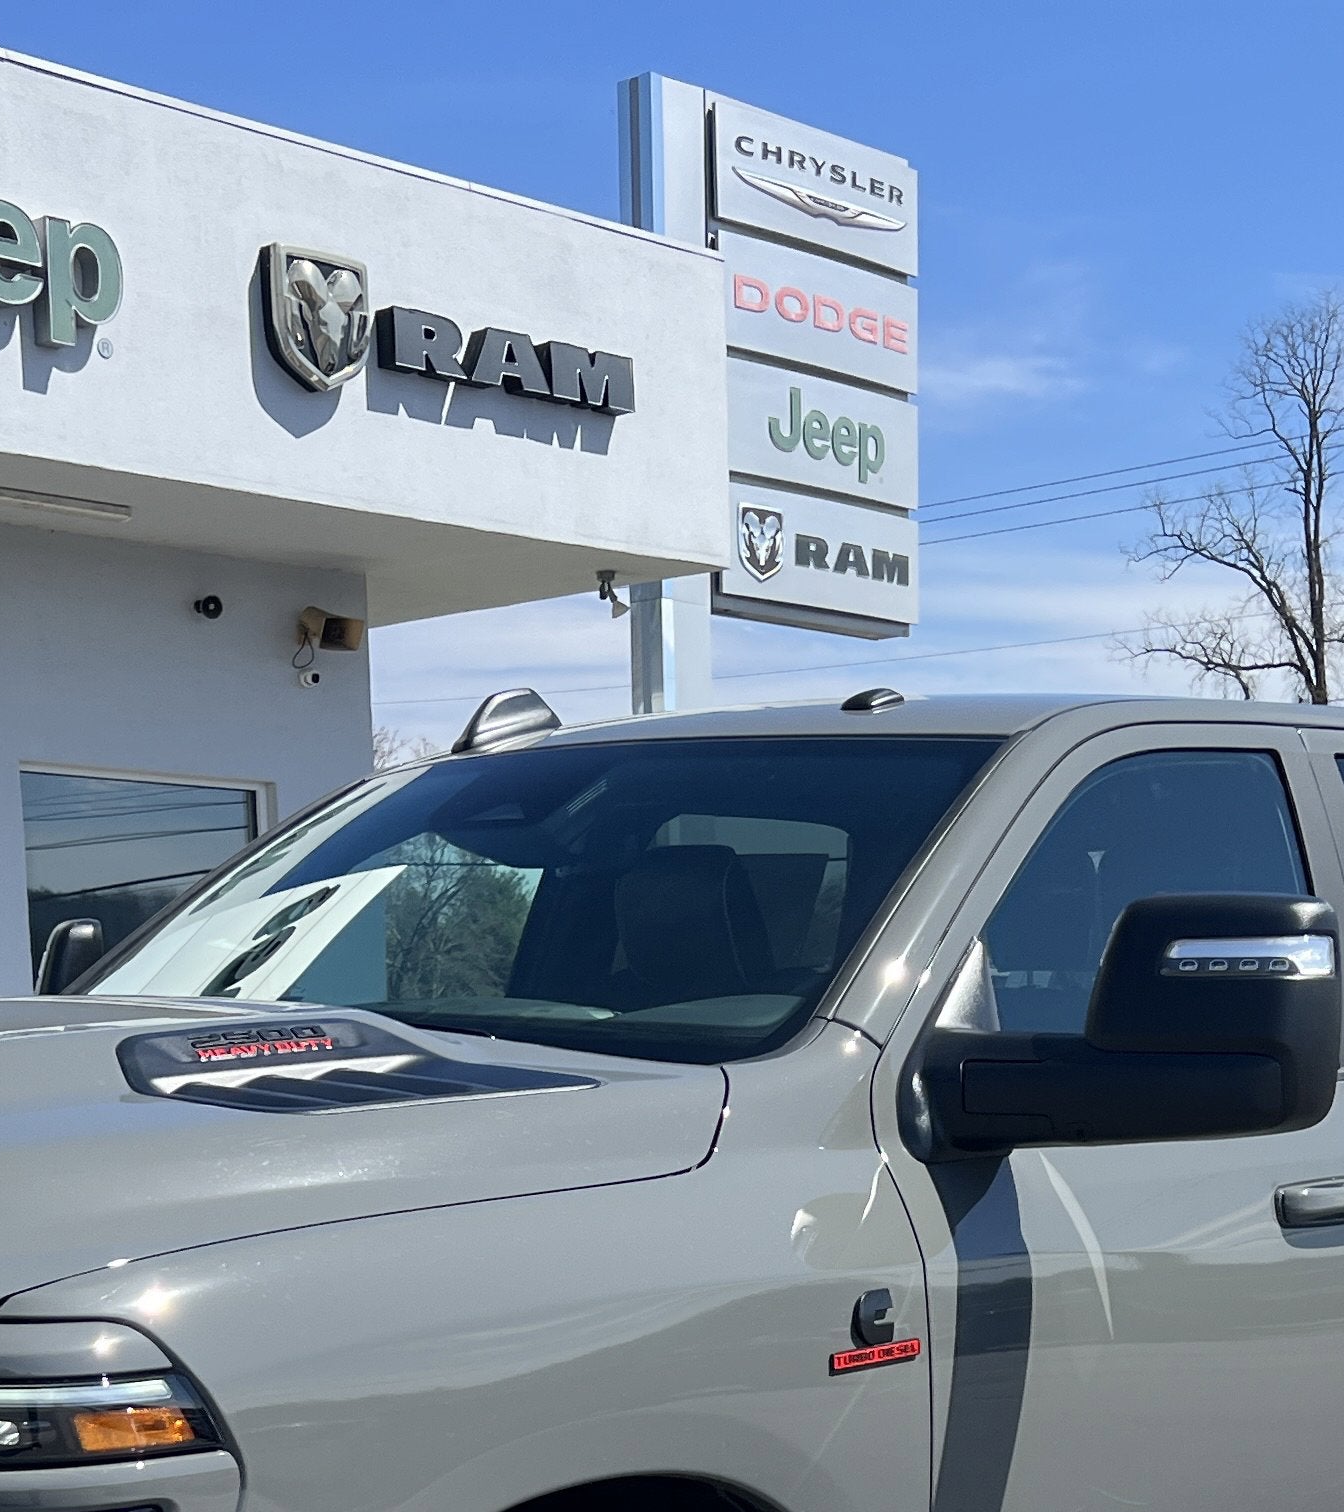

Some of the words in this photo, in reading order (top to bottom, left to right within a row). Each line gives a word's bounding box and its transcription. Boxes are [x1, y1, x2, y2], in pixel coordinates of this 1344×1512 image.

[733, 135, 904, 207] CHRYSLER
[733, 273, 909, 356] DODGE
[375, 305, 635, 416] RAM
[768, 386, 886, 484] Jeep
[794, 533, 910, 587] RAM
[187, 1025, 327, 1049] 2500
[195, 1043, 271, 1062] HEAVY
[273, 1037, 333, 1054] DUTY
